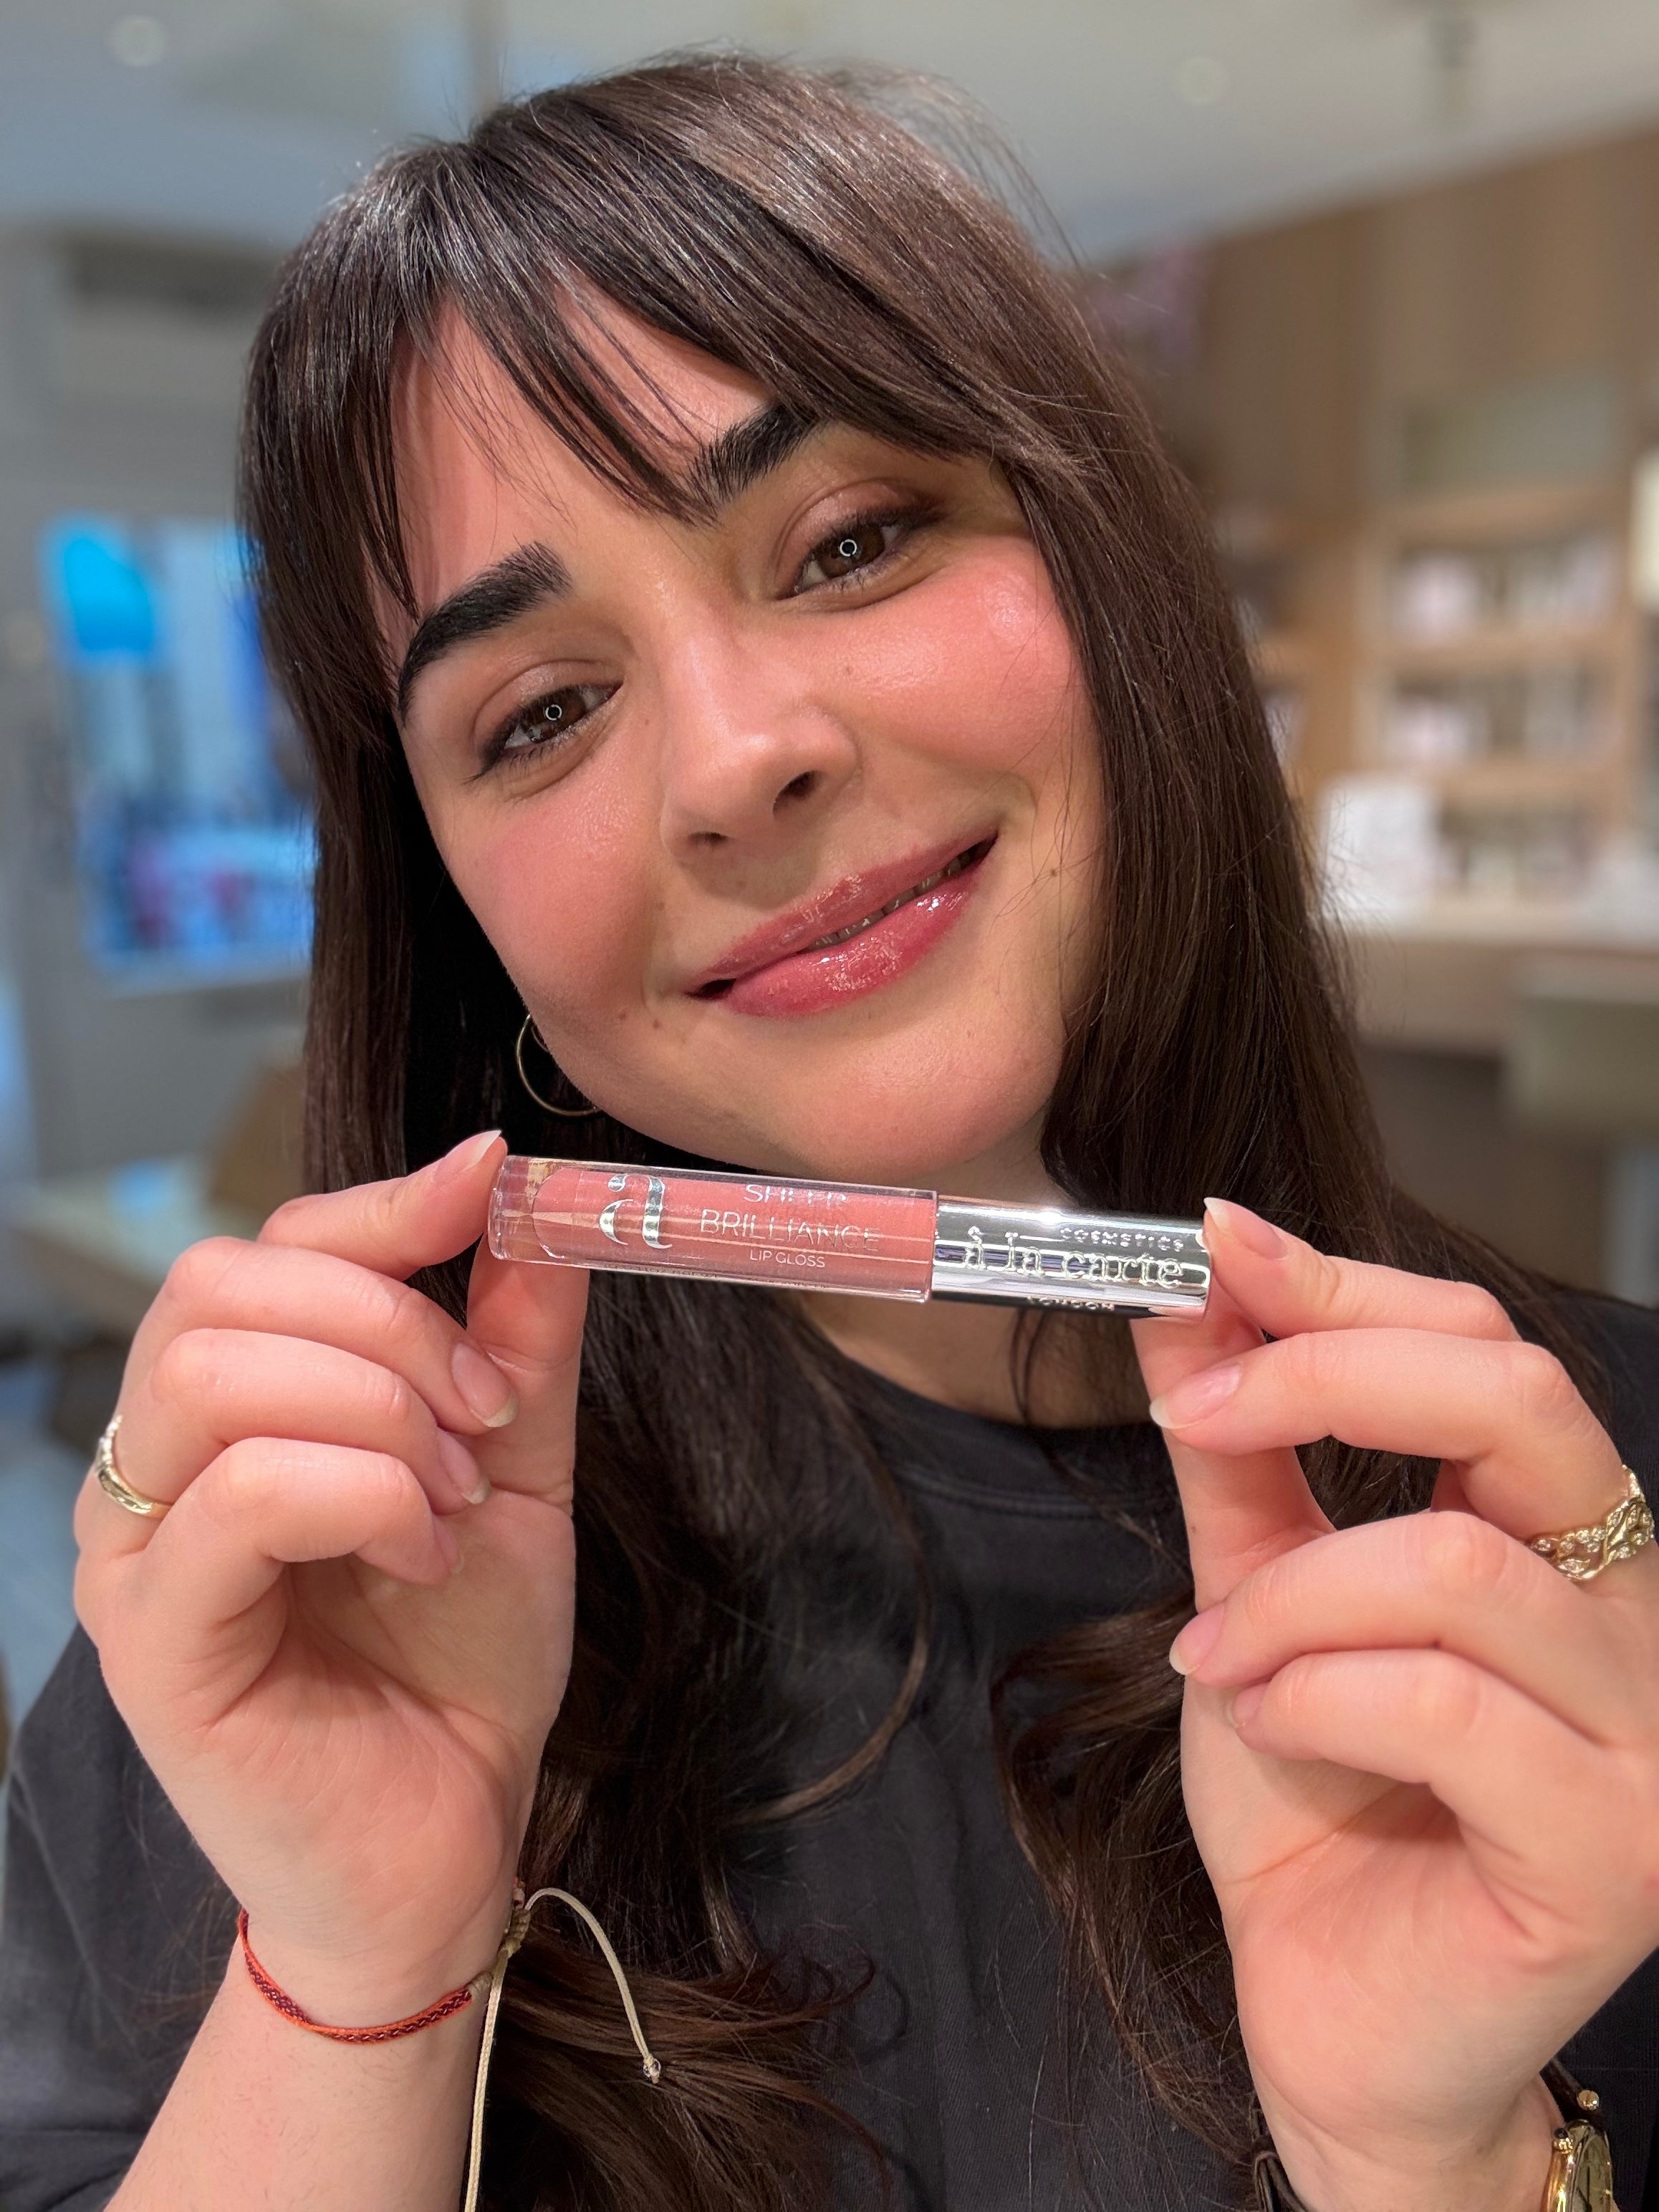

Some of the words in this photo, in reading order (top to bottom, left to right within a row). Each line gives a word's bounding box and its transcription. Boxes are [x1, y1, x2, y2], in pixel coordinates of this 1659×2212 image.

[701, 1208, 880, 1252] BRILLIANCE
[749, 1250, 773, 1262] LIP
[775, 1252, 826, 1268] GLOSS
[1062, 1251, 1184, 1289] carte
